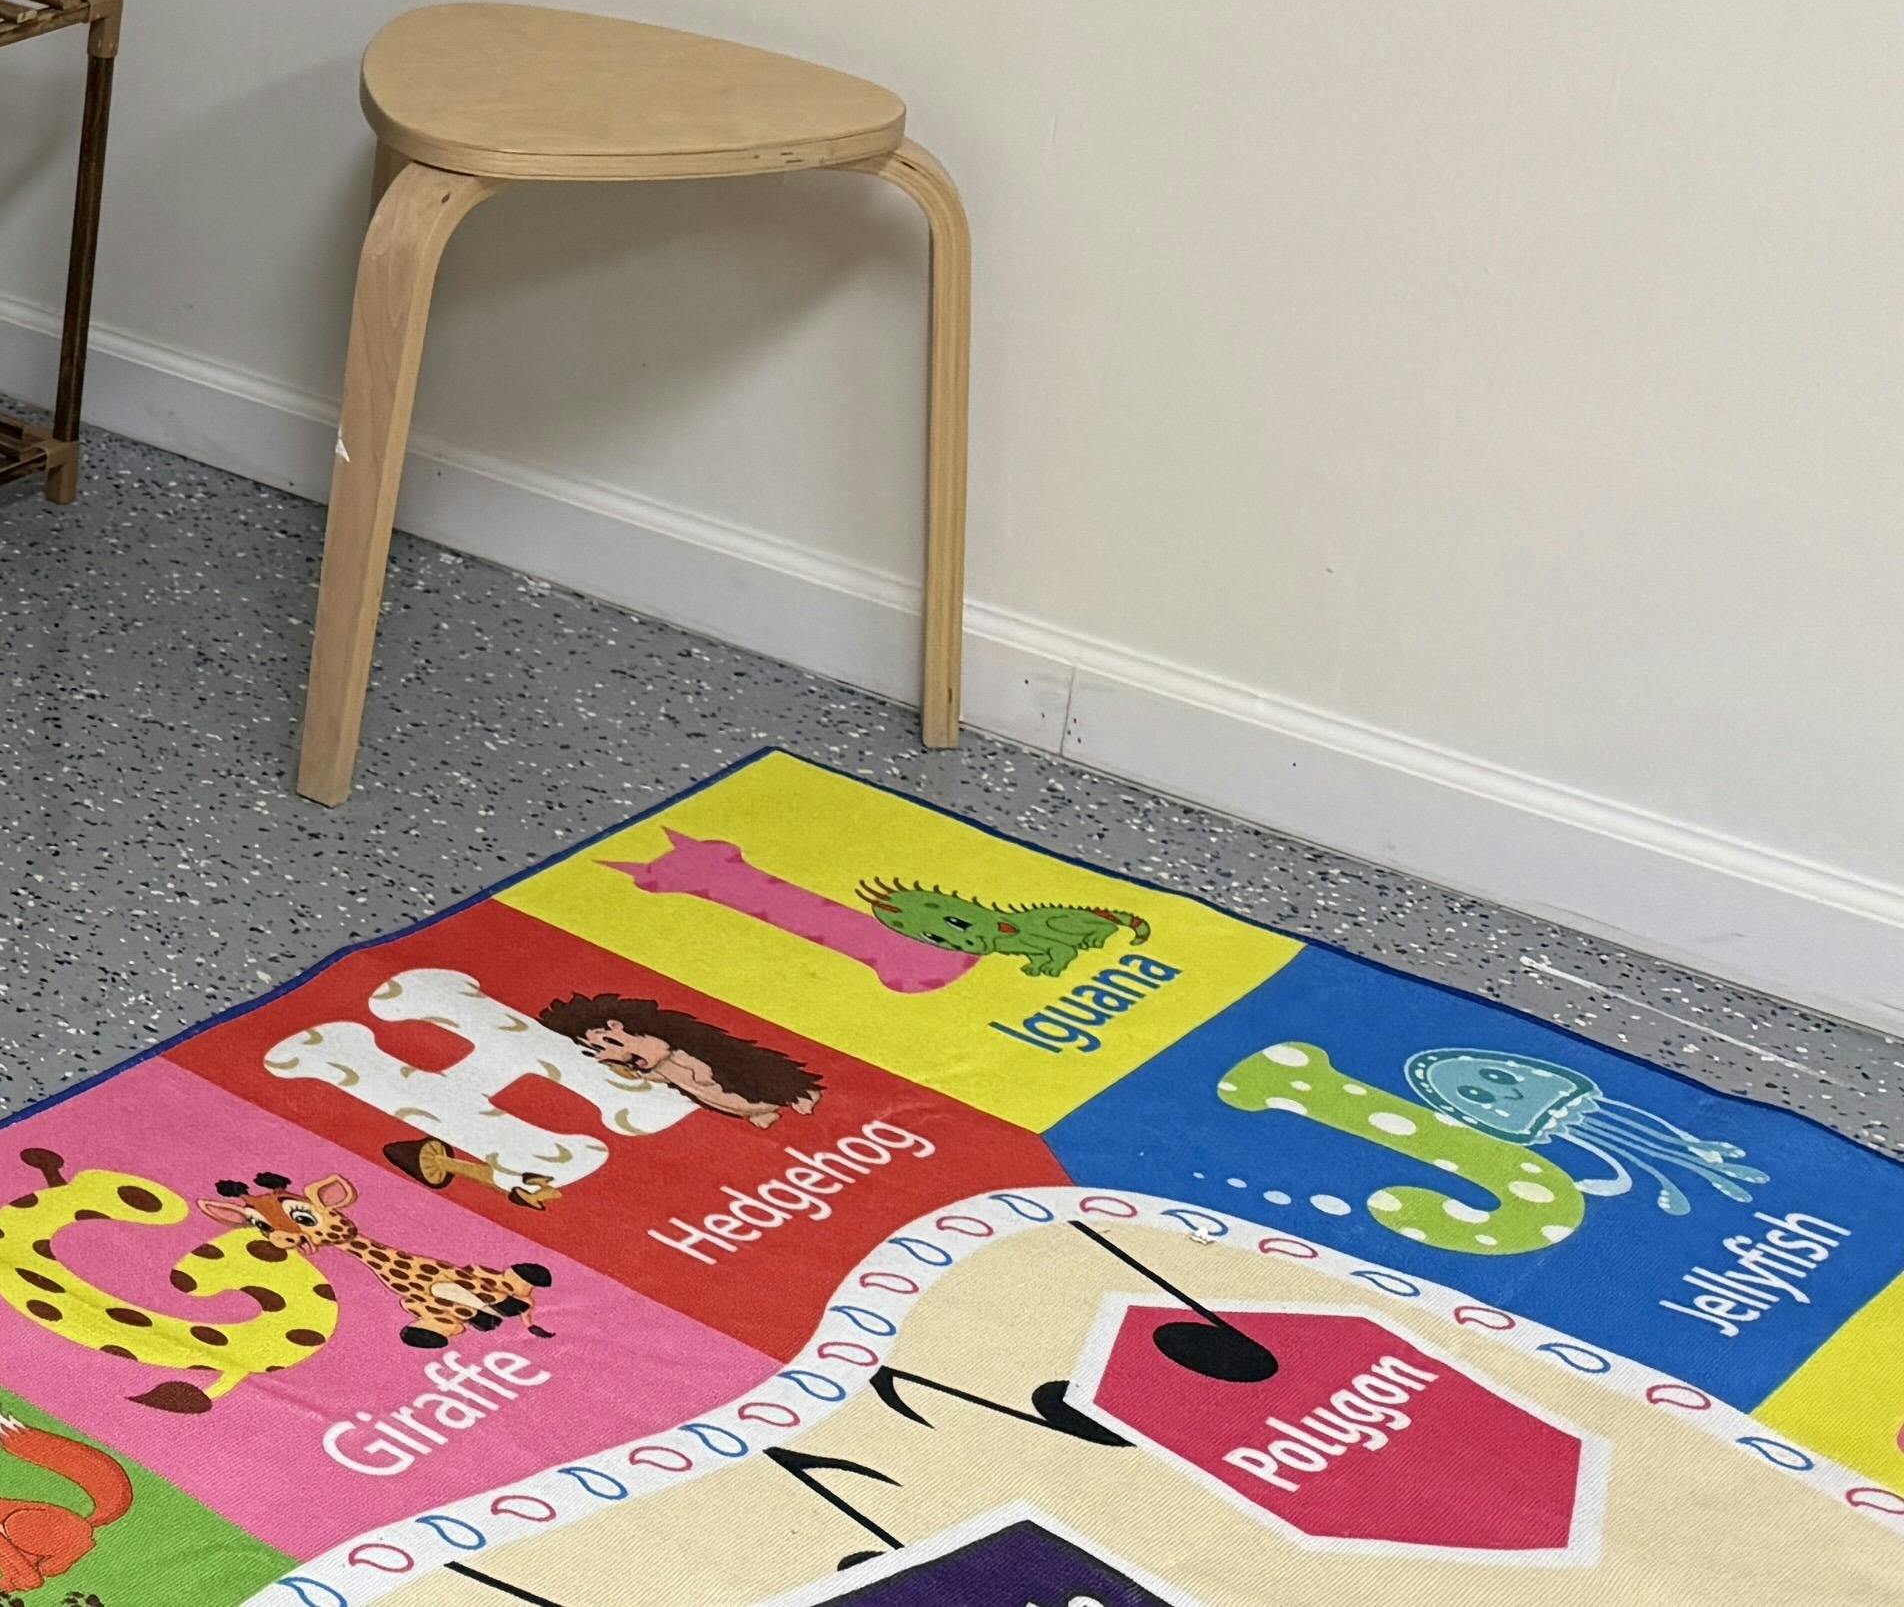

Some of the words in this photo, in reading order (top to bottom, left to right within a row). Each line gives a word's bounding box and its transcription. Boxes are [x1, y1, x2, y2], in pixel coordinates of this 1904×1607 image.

[988, 948, 1181, 1054] Iguana
[647, 1115, 940, 1268] Hedgehog
[1658, 1211, 1852, 1338] Jellyfish
[321, 1341, 553, 1479] Giraffe
[1222, 1353, 1441, 1493] Polygon
